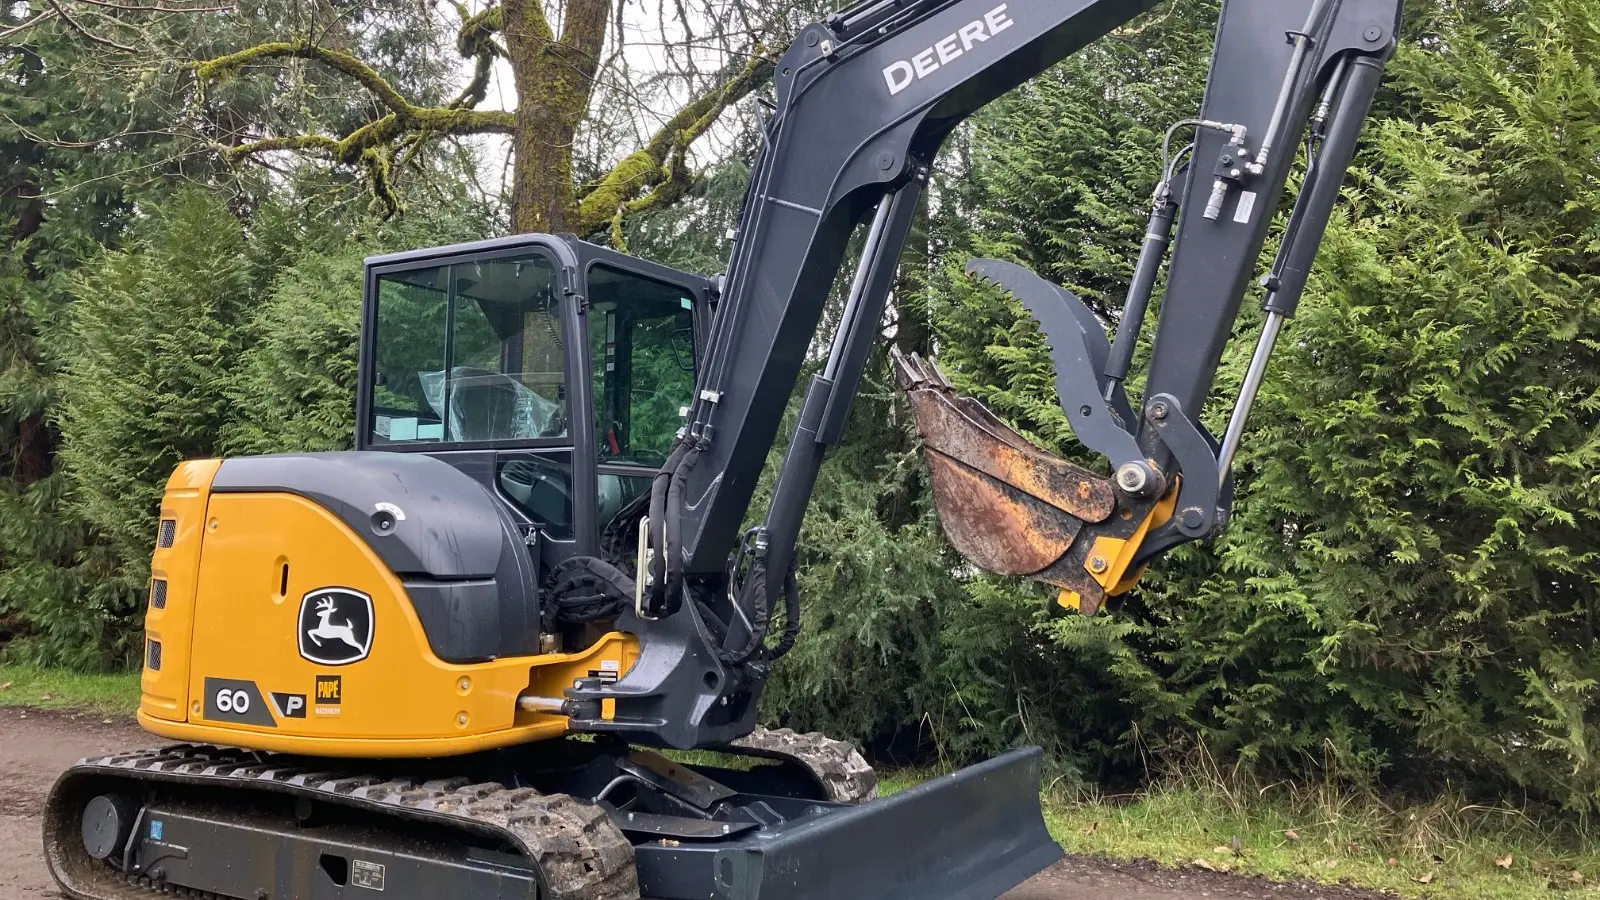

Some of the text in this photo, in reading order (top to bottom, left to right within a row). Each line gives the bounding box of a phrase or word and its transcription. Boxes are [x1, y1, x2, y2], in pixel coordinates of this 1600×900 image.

[882, 3, 1014, 96] DEERE
[216, 688, 304, 715] 60 P
